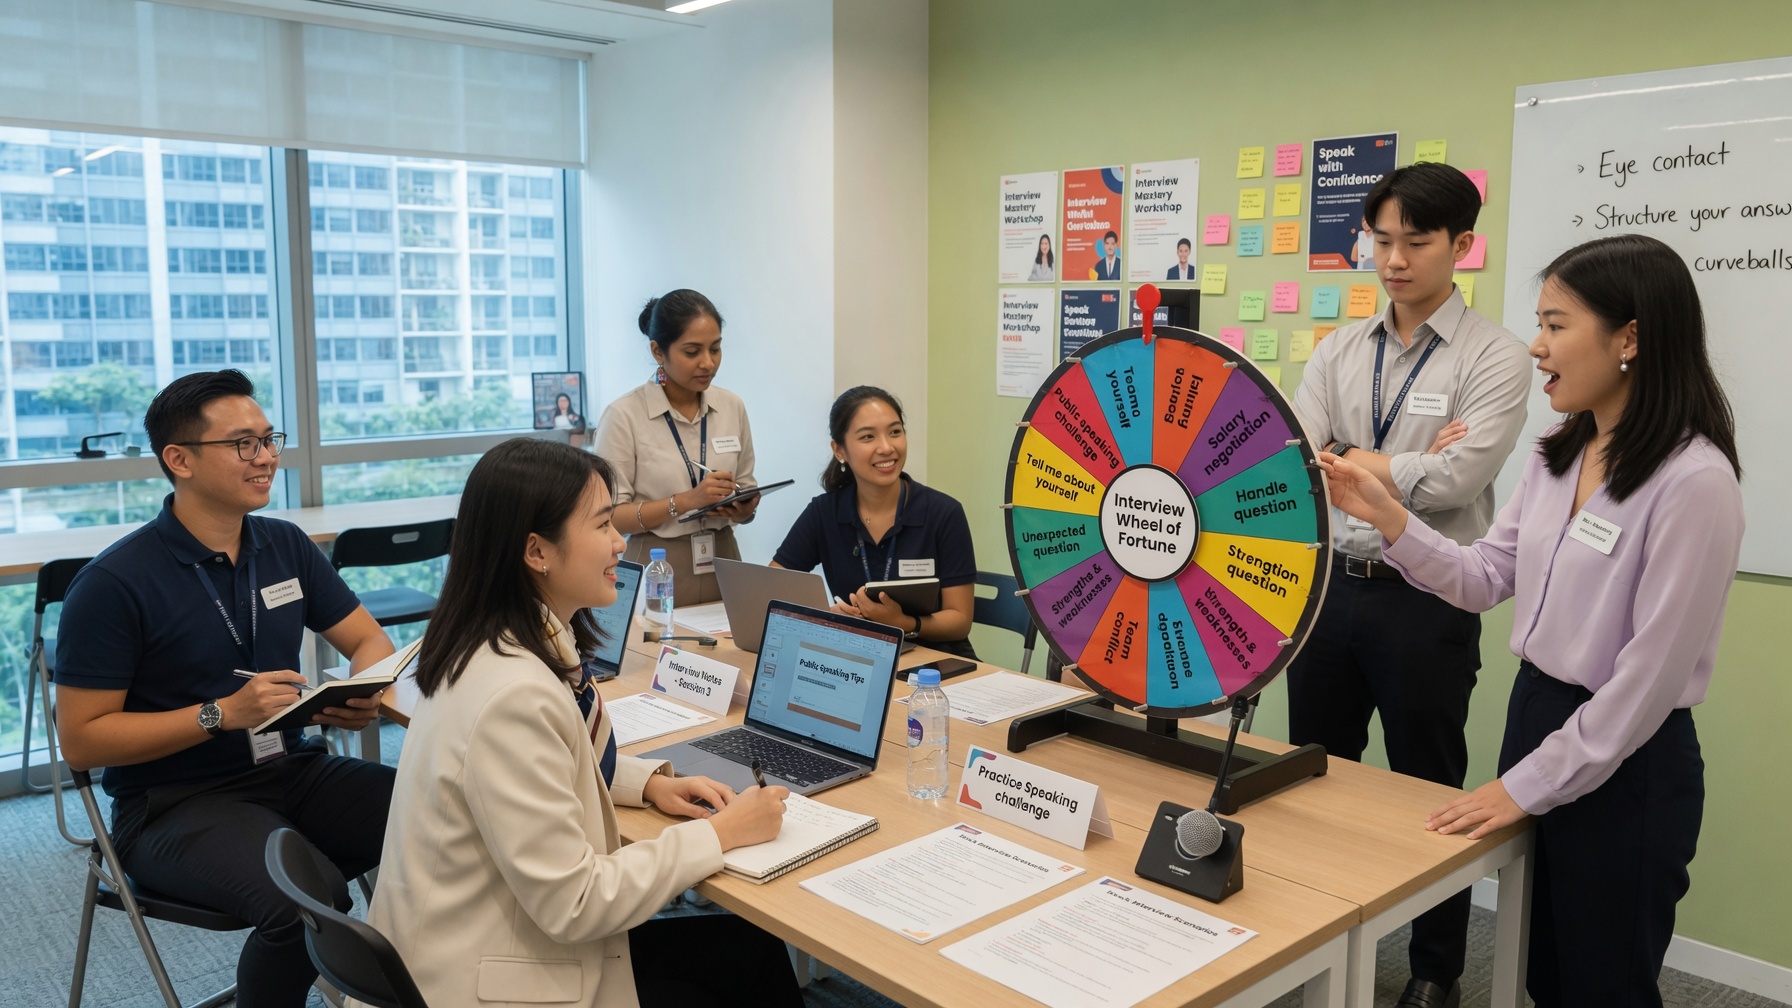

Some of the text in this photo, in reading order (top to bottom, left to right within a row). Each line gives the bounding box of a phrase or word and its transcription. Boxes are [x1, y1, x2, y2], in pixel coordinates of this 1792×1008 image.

[1319, 145, 1355, 161] Speak
[1599, 141, 1730, 187] Eye contact
[1318, 161, 1343, 173] with
[1135, 176, 1179, 188] Interview
[1004, 190, 1041, 201] Interview
[1134, 203, 1182, 214] Workshop
[1595, 204, 1678, 230] Structure
[1690, 206, 1731, 232] your
[1694, 248, 1792, 272] curveballs
[1053, 387, 1081, 420] Public
[1207, 409, 1247, 450] Salary
[1204, 410, 1271, 476] negotiation
[1026, 453, 1096, 495] Tell me about
[1035, 476, 1079, 502] yourself
[1236, 481, 1288, 503] Handle
[1114, 493, 1185, 517] Interview
[1233, 499, 1297, 524] question
[1116, 512, 1182, 536] Wheel of
[1033, 541, 1080, 560] question
[1118, 531, 1177, 554] Fortune
[1092, 563, 1104, 576] &
[1226, 563, 1288, 598] question
[1122, 620, 1139, 660] Team
[799, 658, 819, 671] Public
[705, 686, 712, 697] 3
[1024, 781, 1078, 813] Speaking
